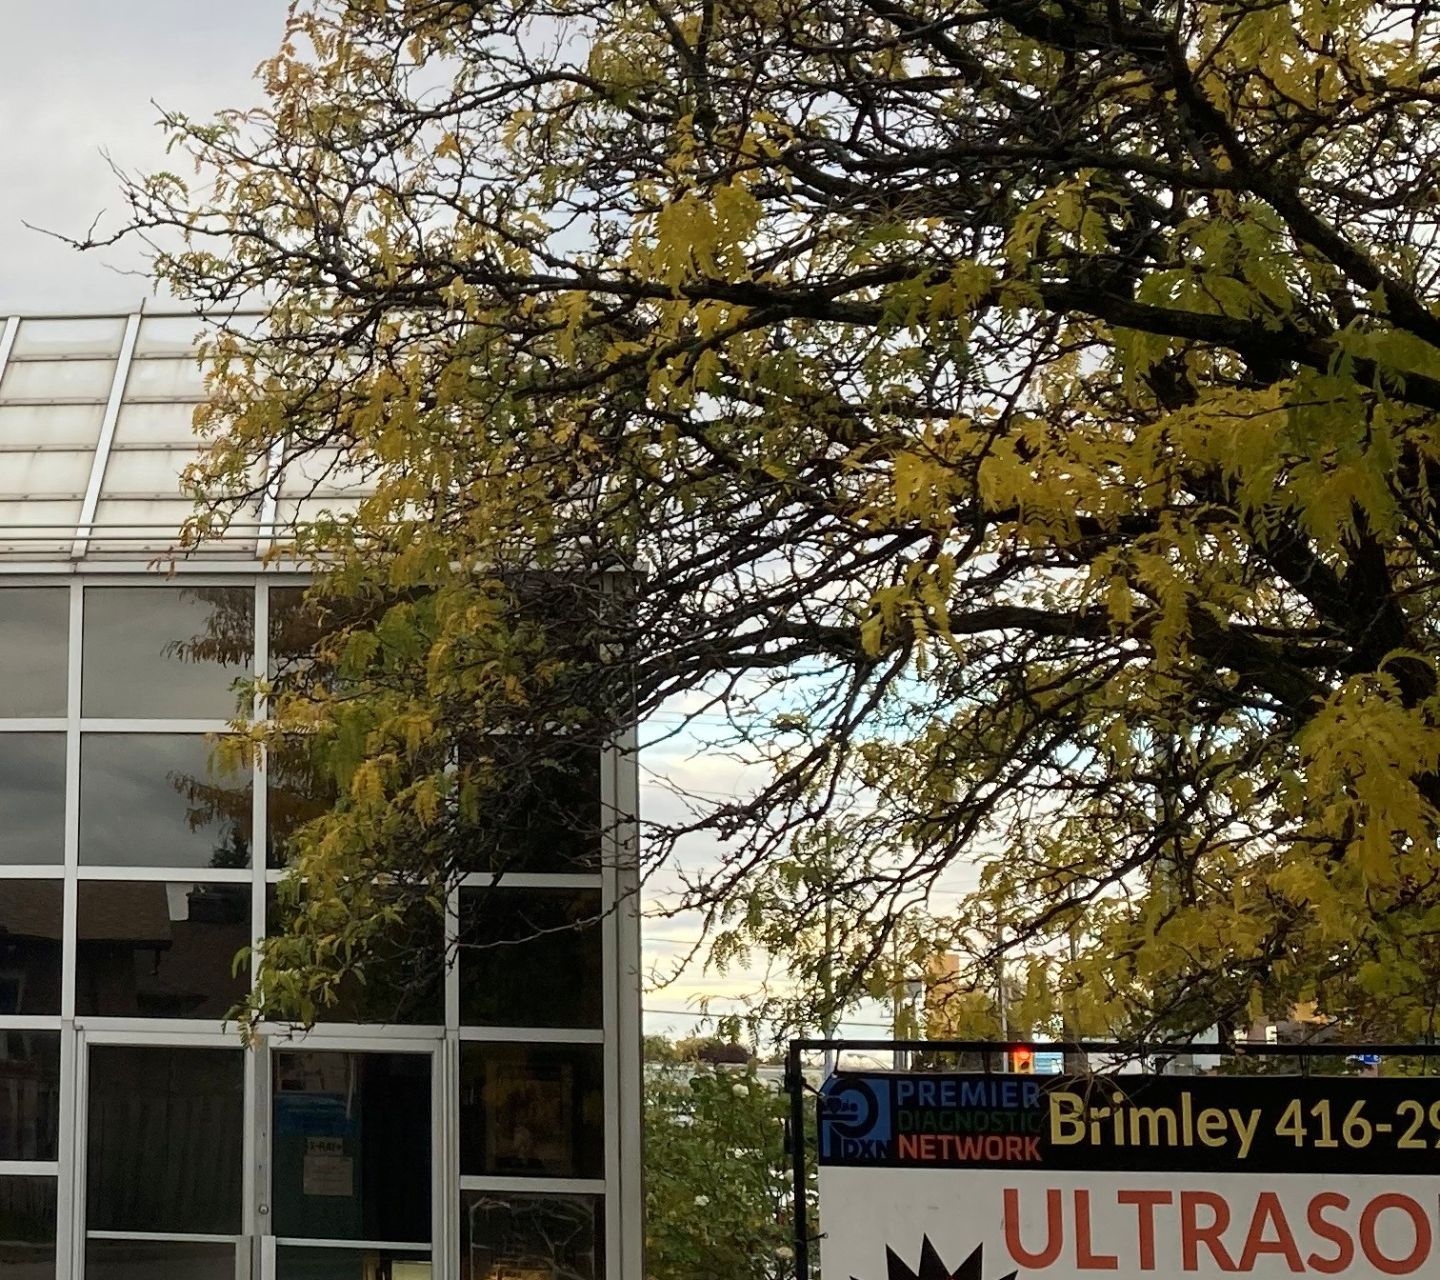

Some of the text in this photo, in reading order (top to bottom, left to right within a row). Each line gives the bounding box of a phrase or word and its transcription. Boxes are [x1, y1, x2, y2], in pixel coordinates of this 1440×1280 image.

[896, 1079, 1041, 1108] PREMIER
[897, 1110, 1042, 1133] DIAGNOSTIC
[1049, 1091, 1262, 1159] Brimley
[898, 1133, 1043, 1162] NETWORK
[1002, 1187, 1440, 1276] ULTRASO
